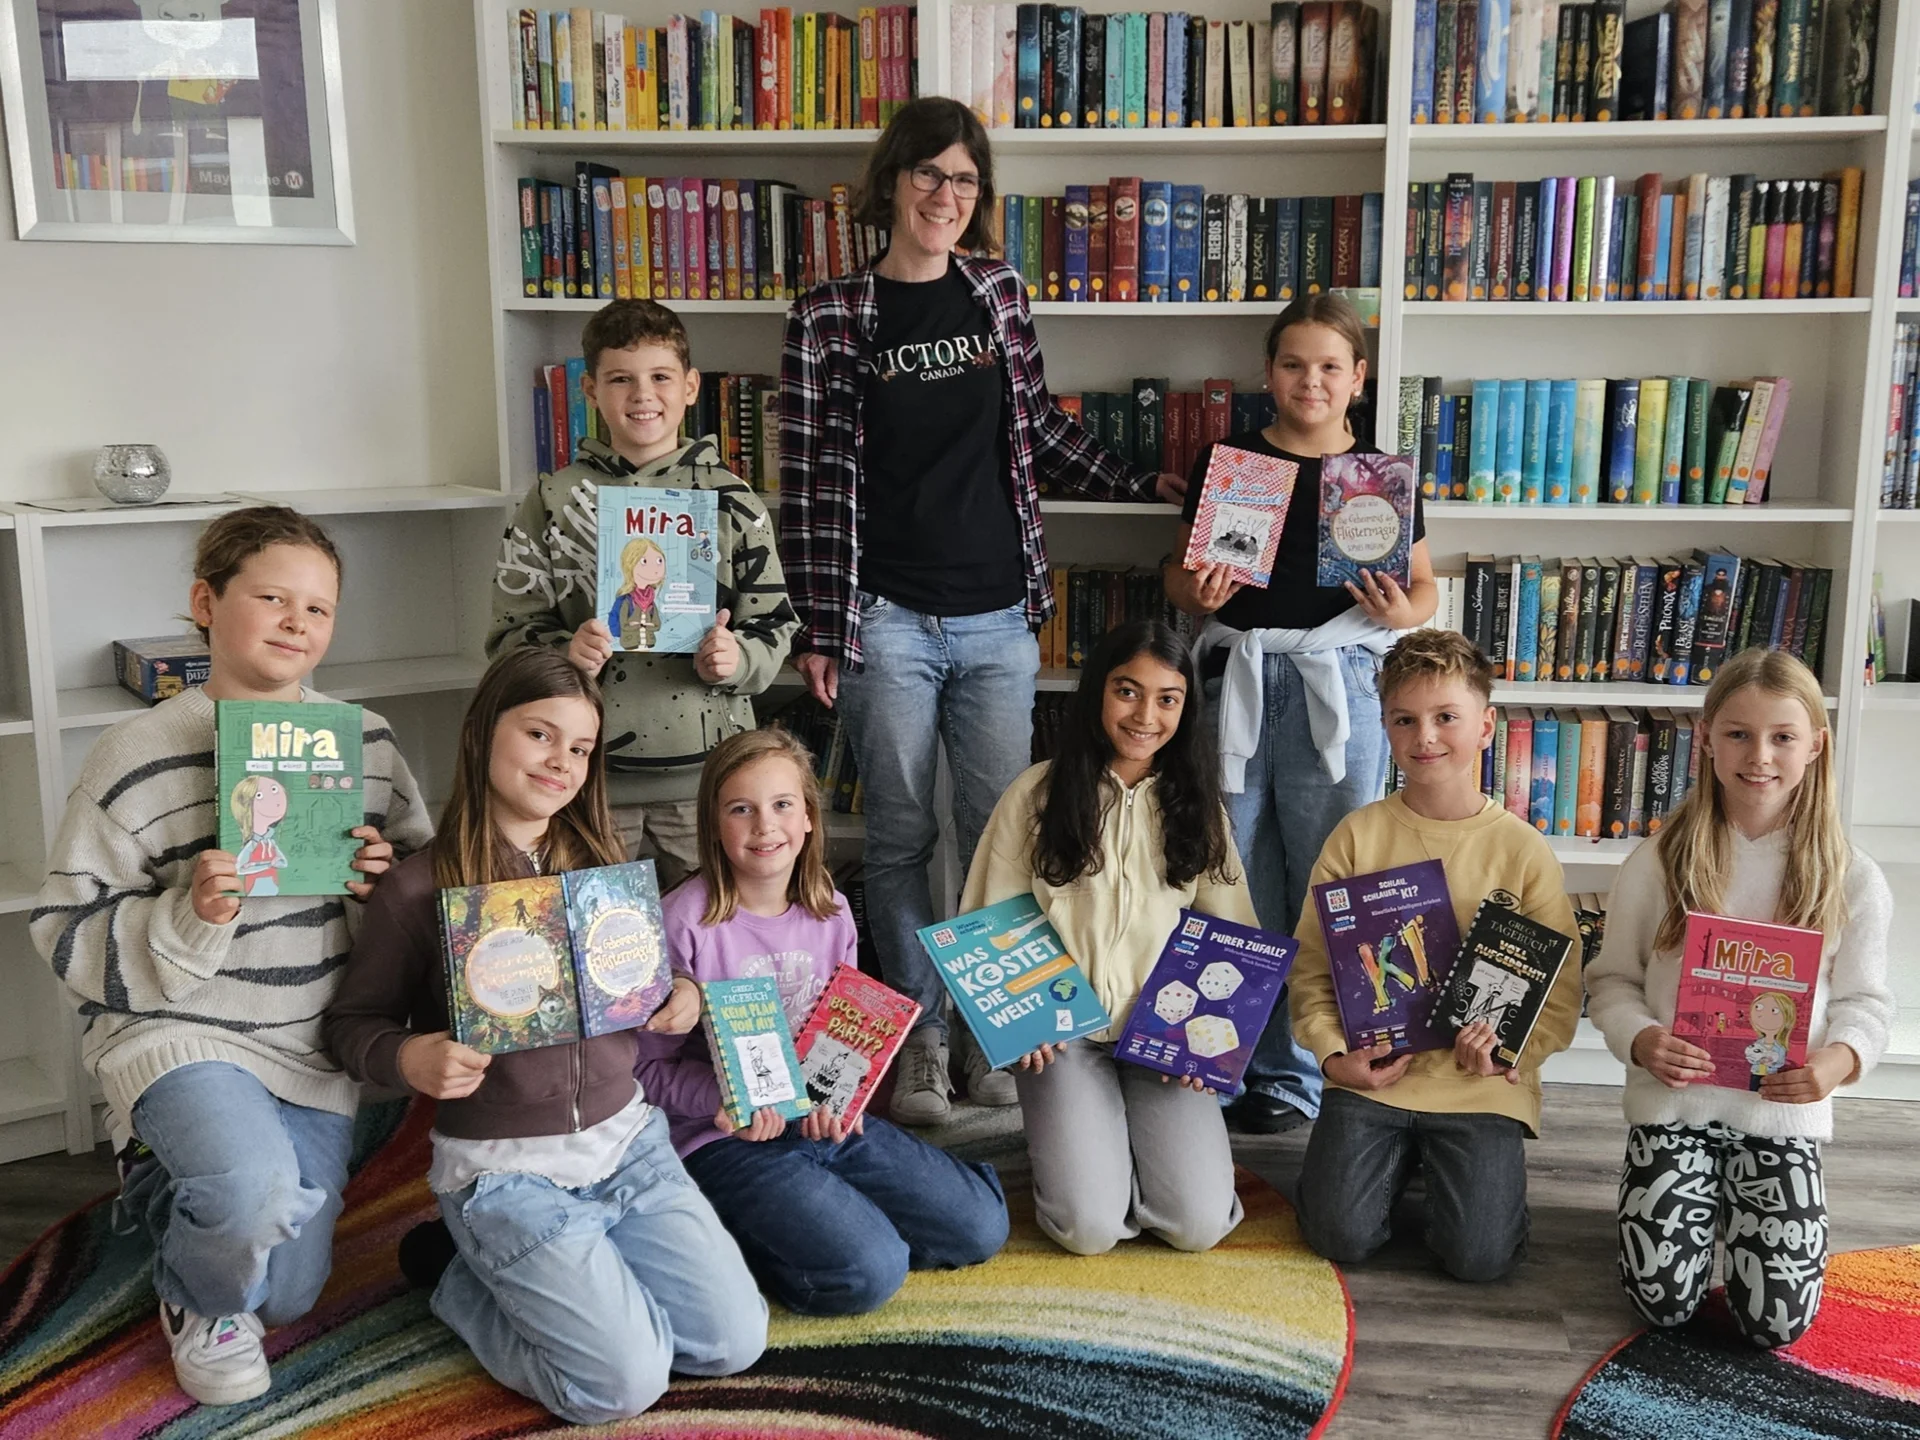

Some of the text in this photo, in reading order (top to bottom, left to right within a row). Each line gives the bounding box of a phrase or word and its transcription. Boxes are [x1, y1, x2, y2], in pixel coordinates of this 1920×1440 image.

[1056, 29, 1071, 77] ANIMOX
[1597, 13, 1618, 99] EVOLUTION
[1207, 220, 1222, 260] EREBOS
[1230, 219, 1243, 267] Saeculum
[1337, 228, 1350, 276] ERAGON
[1251, 233, 1264, 280] ERAGON
[1278, 231, 1291, 278] ERAGON
[1305, 232, 1318, 280] ERAGON
[869, 333, 1000, 377] VICTORIA
[919, 365, 965, 382] CANADA
[1432, 394, 1440, 426] TATTOO
[1692, 393, 1701, 435] GREGOR
[1479, 444, 1487, 455] Die
[1555, 452, 1563, 463] Die
[1208, 487, 1287, 506] Schlamassel!
[1231, 478, 1266, 492] So ein
[625, 505, 696, 539] Mira
[1336, 523, 1397, 541] Flüstermagie
[1472, 568, 1489, 612] Schattenauge
[1563, 587, 1576, 615] Willow
[1581, 587, 1594, 615] Willow
[1601, 587, 1613, 615] Willow
[1637, 581, 1653, 614] SEELEN
[1634, 624, 1646, 648] BUCH
[1675, 619, 1687, 646] BEAST
[1493, 640, 1506, 663] EMMA
[252, 721, 339, 759] Mira
[1565, 728, 1574, 750] CRAY
[1495, 779, 1503, 791] Der
[1613, 747, 1627, 811] Die Beschenkte
[1651, 761, 1661, 784] MAGIC
[1654, 754, 1670, 796] GUARDIANS
[1328, 889, 1345, 898] WAS
[1400, 885, 1419, 900] KI?
[1331, 903, 1348, 911] WAS
[1397, 902, 1422, 912] Intelligenz
[1184, 929, 1201, 937] WAS
[1189, 919, 1205, 927] WAS
[1489, 920, 1559, 954] TAGEBUCH 17
[1508, 919, 1538, 937] GREGS
[592, 944, 654, 972] Flüstermagie
[1209, 932, 1287, 959] PURER ZUFALL?
[1499, 939, 1528, 961] VOLL
[1713, 938, 1796, 980] Mira
[943, 946, 989, 975] WAS
[1357, 925, 1431, 1008] KI
[1473, 943, 1548, 984] AUFGEDREHT!
[722, 992, 769, 1005] TAGEBUCH
[731, 985, 755, 993] GREGS
[974, 988, 1009, 1013] DIE
[720, 1000, 778, 1020] KEIN PLAN
[829, 995, 899, 1036] BOCK AUF
[986, 992, 1045, 1029] WELT?
[729, 1016, 776, 1033] VON NIX
[828, 1016, 885, 1055] PARTY?
